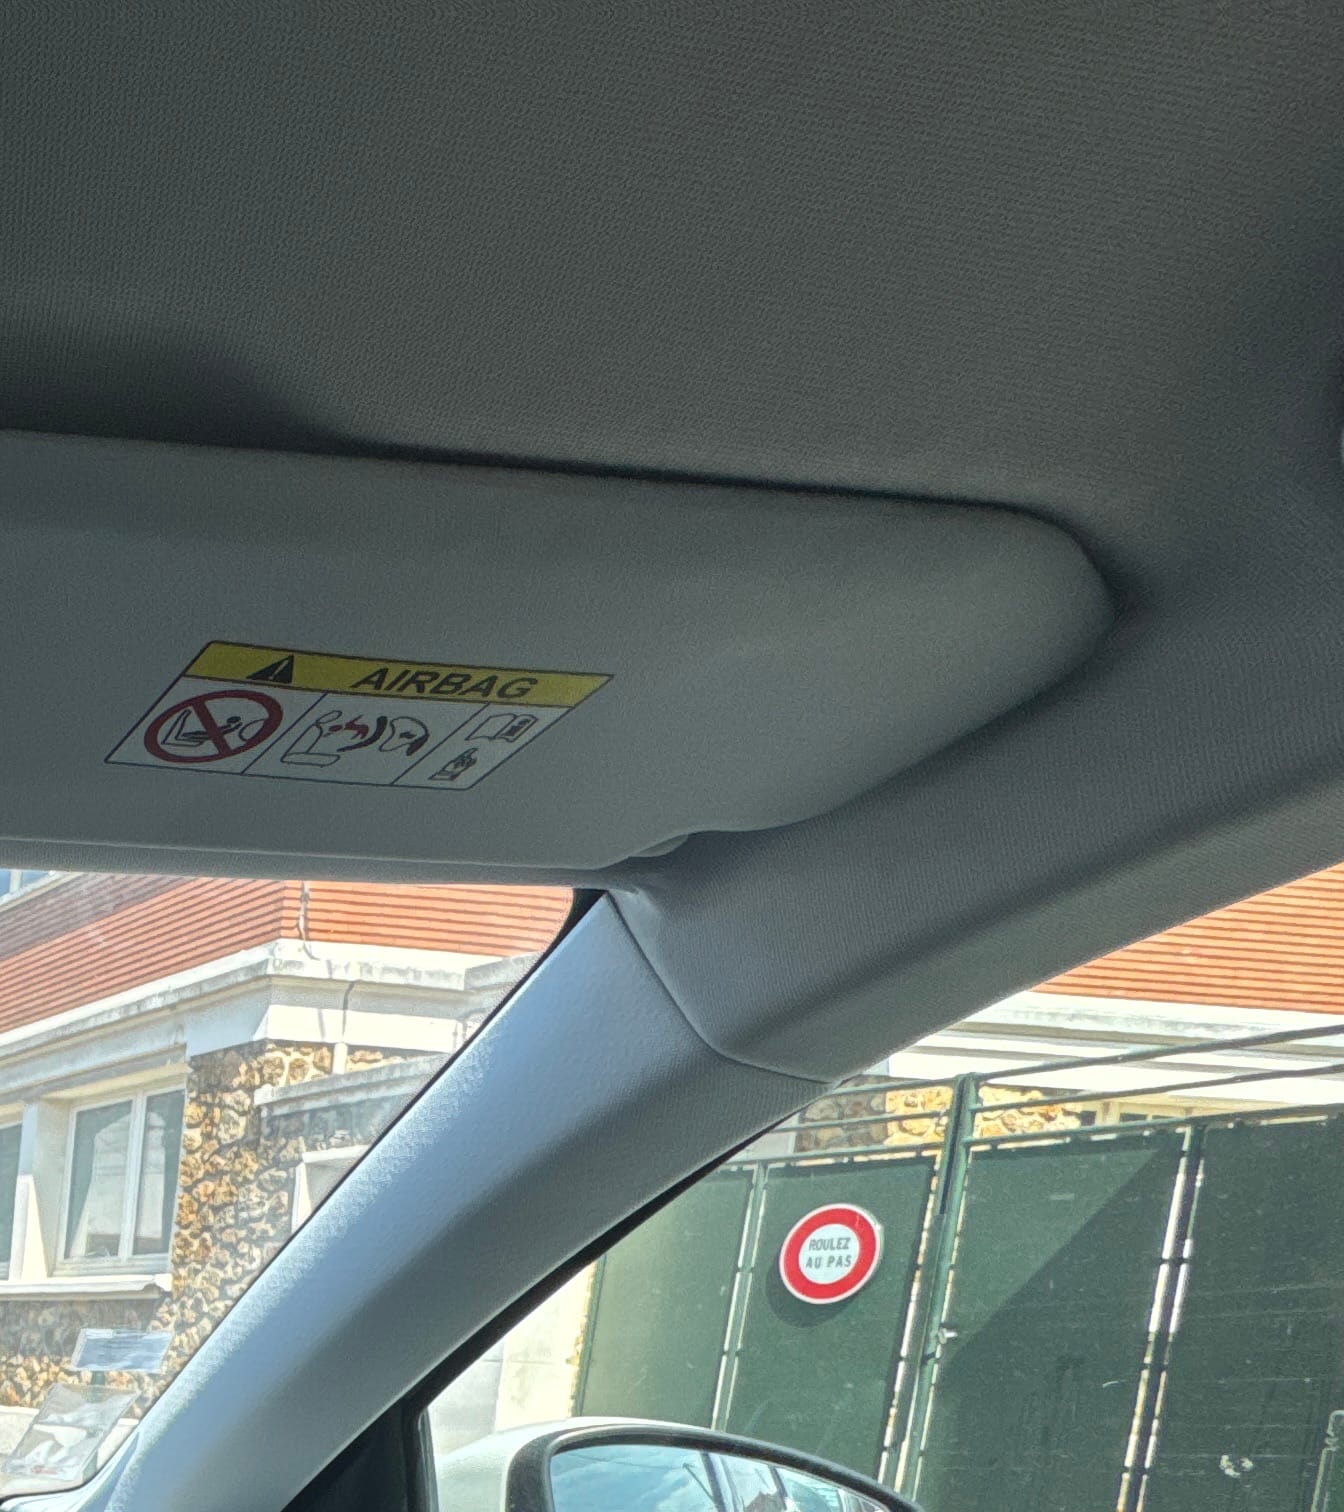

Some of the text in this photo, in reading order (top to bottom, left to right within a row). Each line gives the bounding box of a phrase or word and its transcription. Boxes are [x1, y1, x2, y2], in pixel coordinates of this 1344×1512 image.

[348, 667, 538, 700] AIRBAG
[808, 1237, 851, 1251] ROULEZ
[805, 1255, 852, 1268] AU PAS
